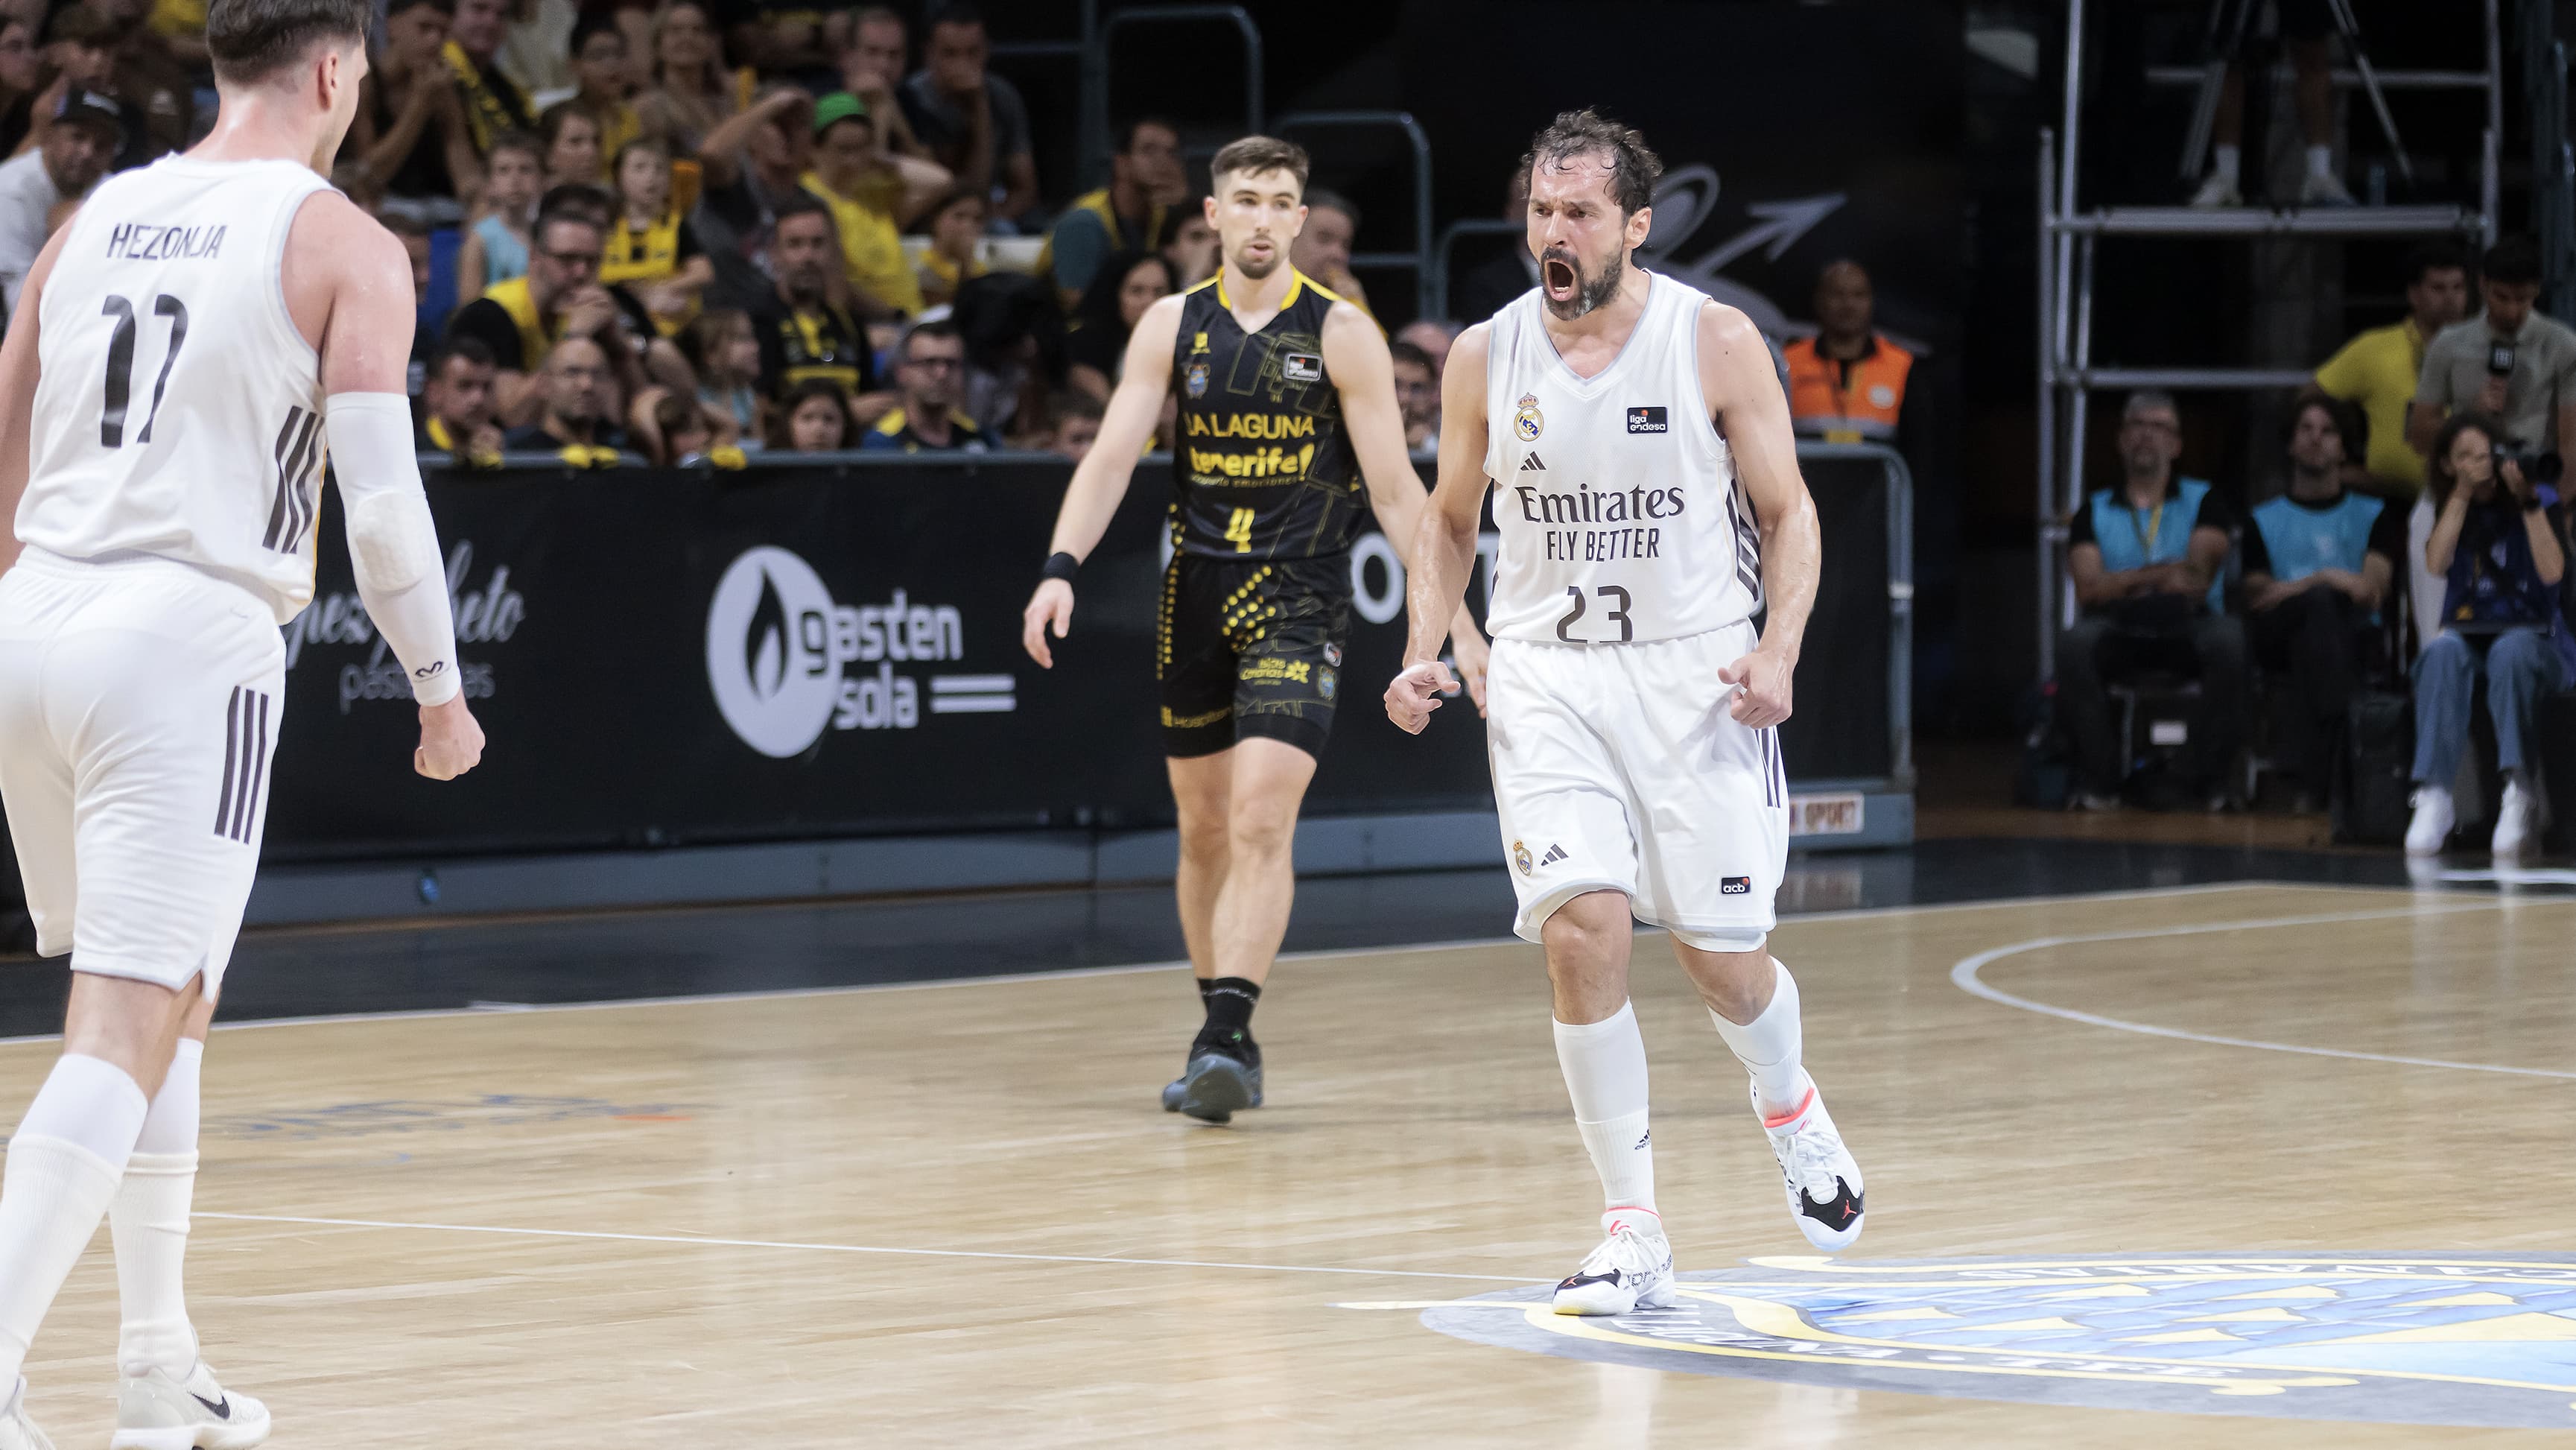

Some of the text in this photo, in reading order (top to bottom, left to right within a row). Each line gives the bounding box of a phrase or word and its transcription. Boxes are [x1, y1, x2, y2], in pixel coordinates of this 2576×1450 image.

[107, 223, 227, 261] HEZONJA
[1210, 413, 1316, 440] LAGUNA
[1630, 414, 1647, 424] liga
[1630, 422, 1666, 431] endesa
[1514, 483, 1685, 524] Emirates
[1224, 507, 1255, 554] 4
[1546, 528, 1660, 562] FLY BETTER
[800, 587, 964, 678] gasten
[1556, 585, 1634, 645] 23
[833, 659, 919, 730] sola
[1723, 883, 1746, 893] acb
